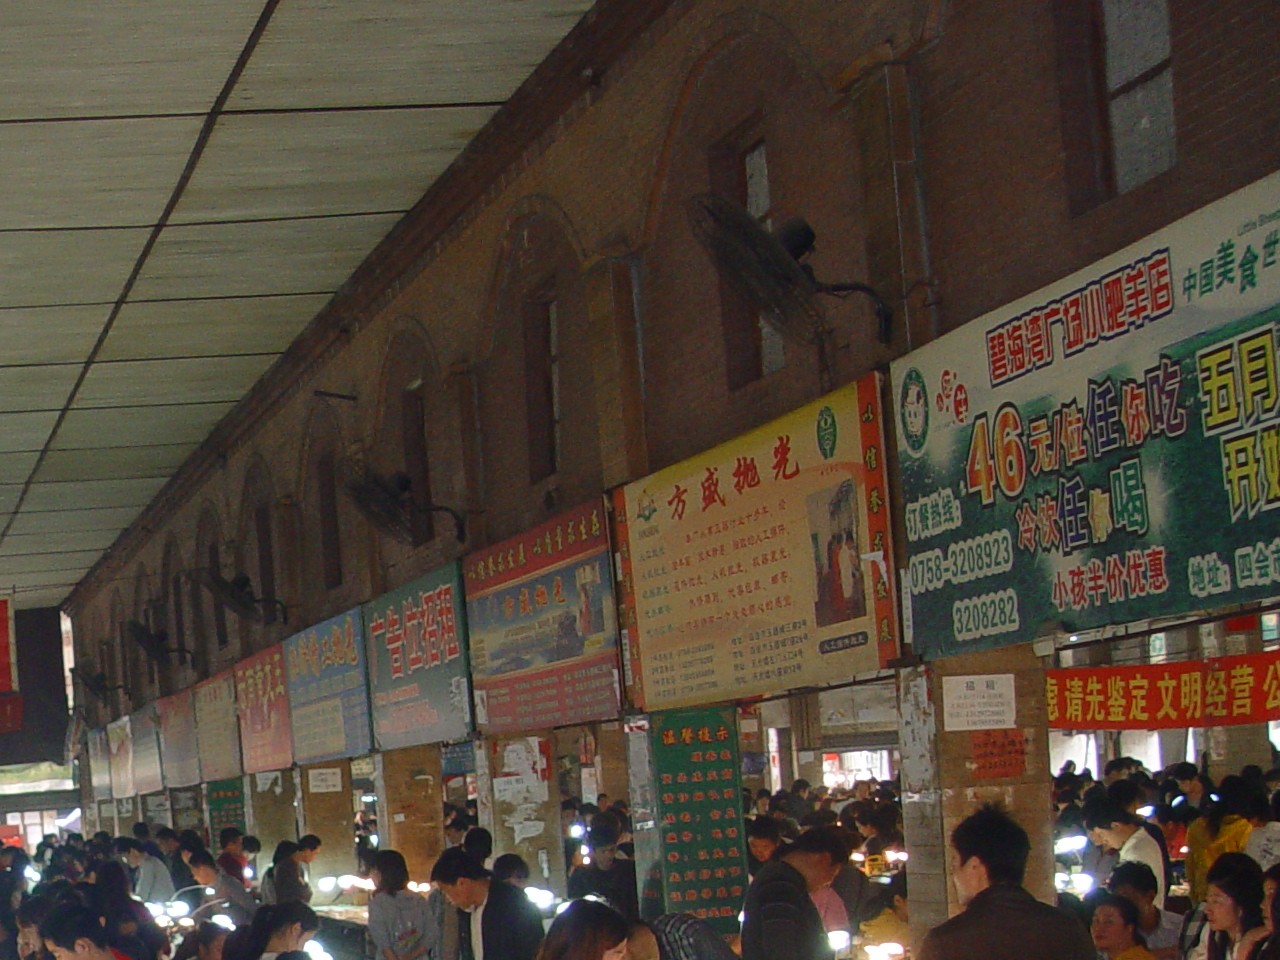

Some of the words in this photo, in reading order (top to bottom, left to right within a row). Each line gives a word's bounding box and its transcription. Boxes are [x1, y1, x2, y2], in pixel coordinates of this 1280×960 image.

[988, 252, 1173, 384] 碧海湾广场小肥羊店
[910, 534, 1011, 591] 0758-3208923
[1053, 548, 1167, 610] 小孩半价优惠
[955, 597, 1018, 637] 3208282
